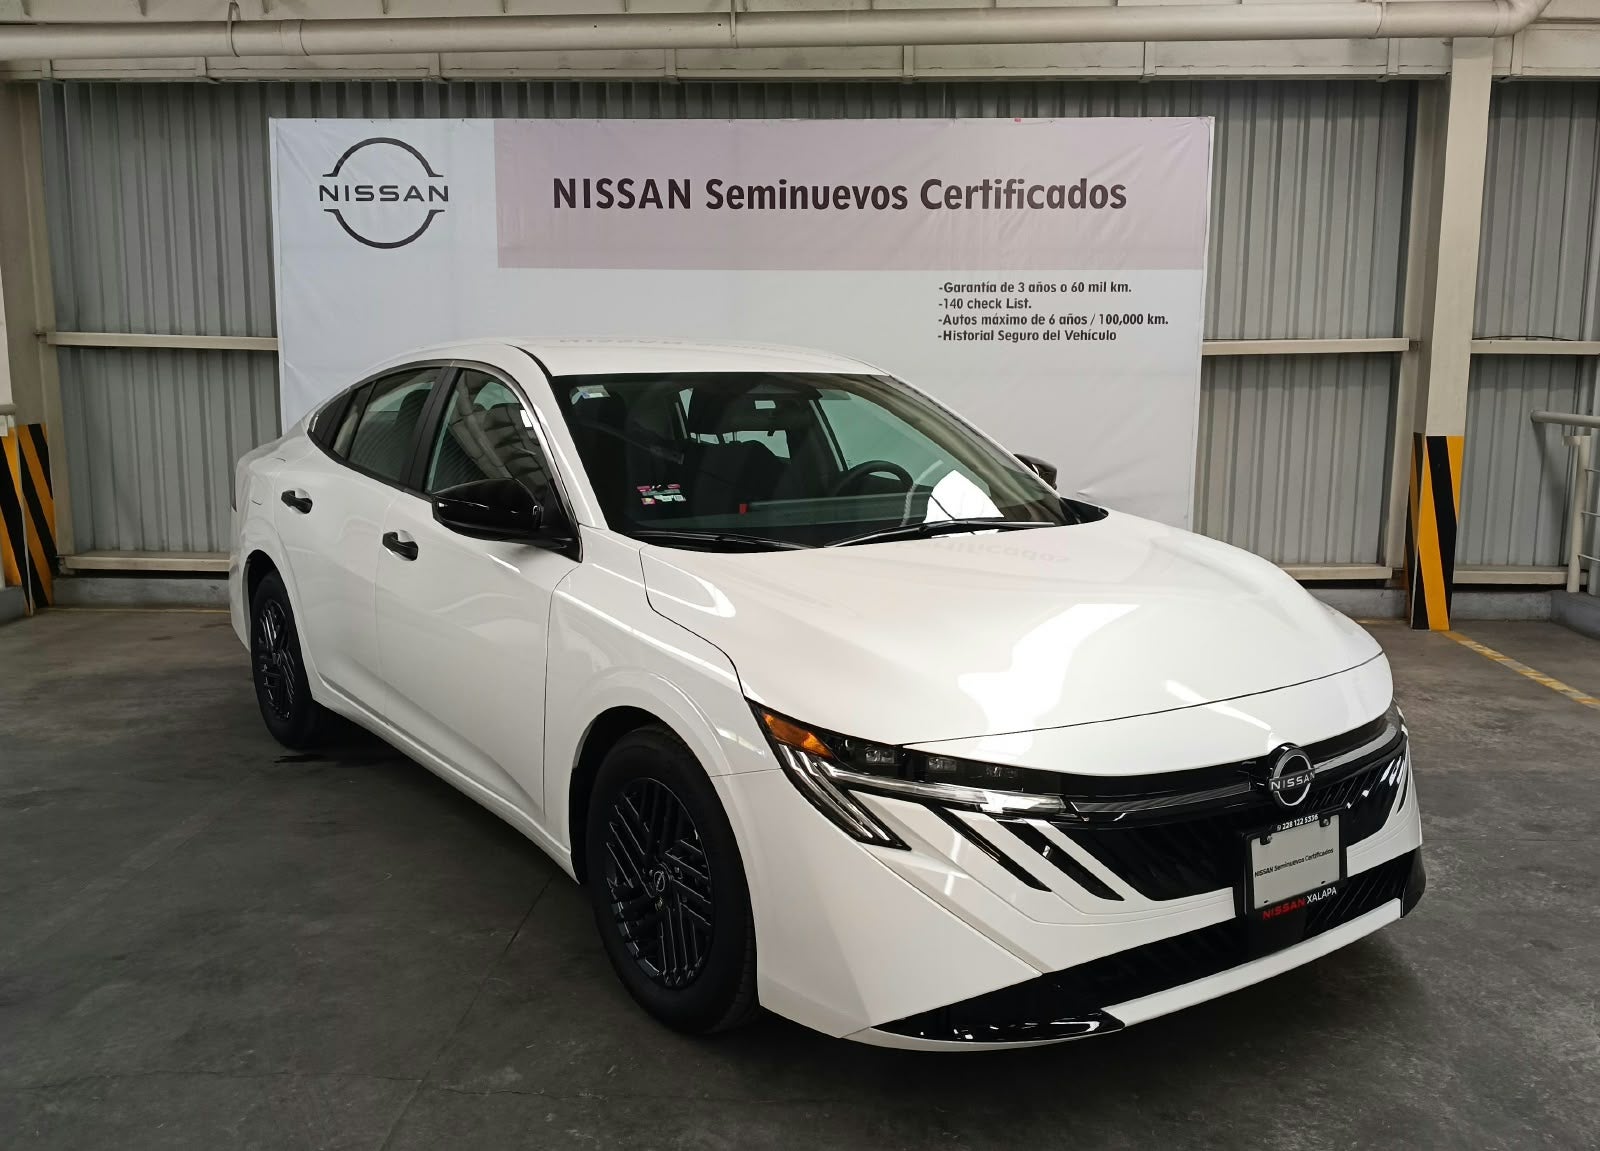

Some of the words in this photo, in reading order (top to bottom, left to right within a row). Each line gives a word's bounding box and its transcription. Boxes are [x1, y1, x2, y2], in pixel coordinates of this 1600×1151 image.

[319, 184, 449, 202] NISSAN
[553, 177, 691, 209] NISSAN
[705, 178, 908, 210] Seminuevos
[920, 177, 1127, 210] Certificados
[938, 281, 997, 293] -Garantía
[1000, 281, 1015, 293] de
[1017, 281, 1025, 293] 3
[1028, 281, 1057, 293] años
[1060, 283, 1068, 293] o
[1070, 281, 1085, 293] 60
[1088, 281, 1107, 293] mil
[1110, 281, 1132, 293] km.
[938, 298, 964, 310] -140
[967, 298, 1002, 310] check
[1006, 297, 1032, 310] List.
[938, 313, 978, 326] -Autos
[981, 312, 1028, 326] máximo
[1030, 313, 1046, 326] de
[1048, 313, 1056, 326] 6
[1058, 313, 1088, 326] años
[1089, 313, 1096, 327] /
[1099, 313, 1144, 327] 100,000
[1147, 312, 1169, 325] km.
[937, 329, 995, 342] -Historial
[997, 329, 1040, 344] Seguro
[1042, 329, 1061, 341] del
[1064, 328, 1117, 342] Vehículo
[1271, 772, 1315, 791] NISSAN
[1254, 866, 1274, 878] NISSAN
[1274, 857, 1305, 872] Seminuevos
[1304, 848, 1334, 862] Certificados
[1263, 899, 1306, 920] NISSAN
[1306, 886, 1337, 904] XALAPA
